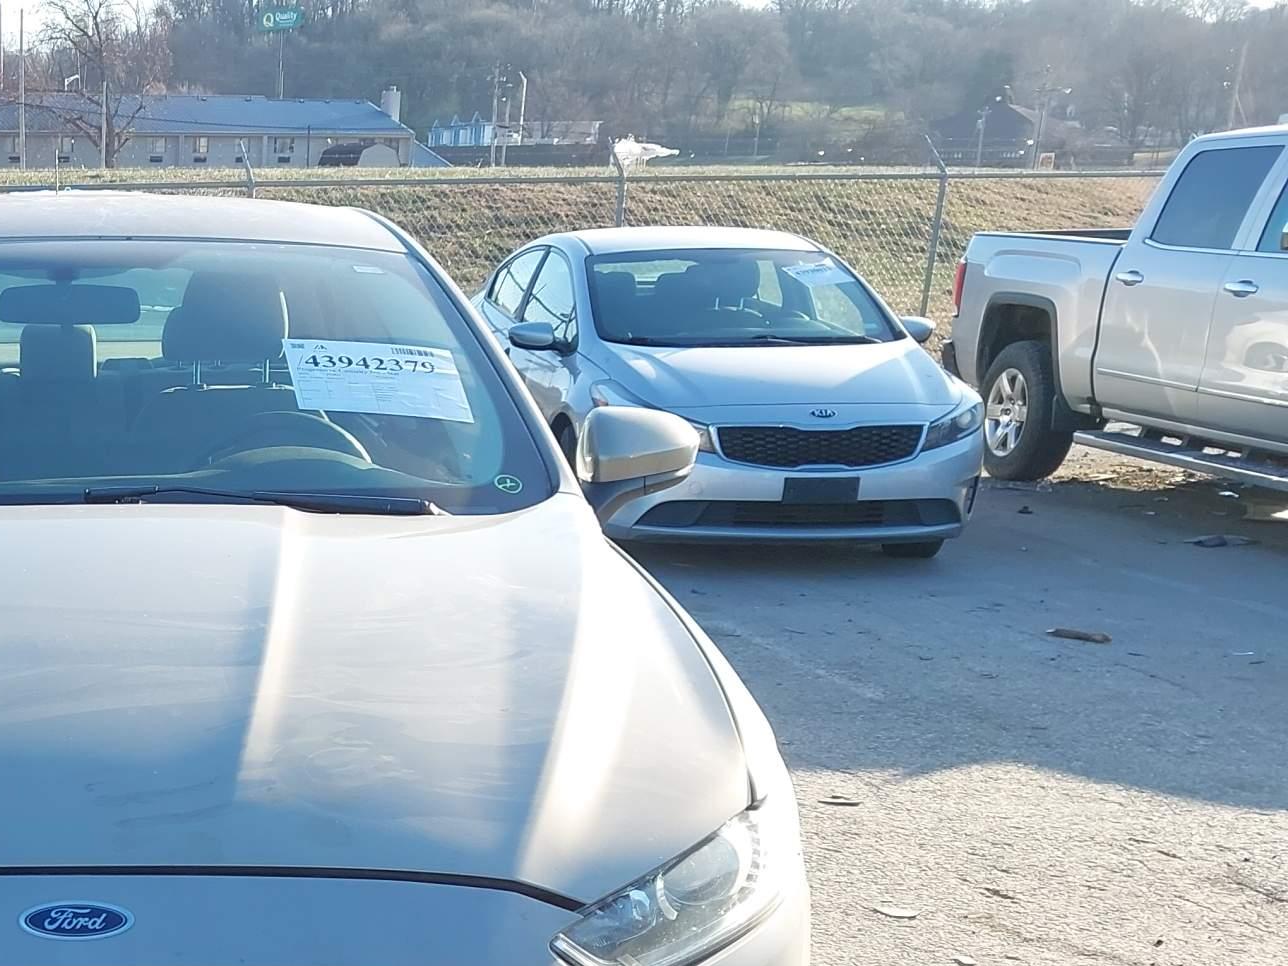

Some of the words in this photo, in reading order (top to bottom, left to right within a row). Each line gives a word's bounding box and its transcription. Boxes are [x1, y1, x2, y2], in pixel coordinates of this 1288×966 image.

[275, 11, 297, 22] Quality
[812, 408, 835, 417] KIA
[44, 908, 107, 930] Ford
